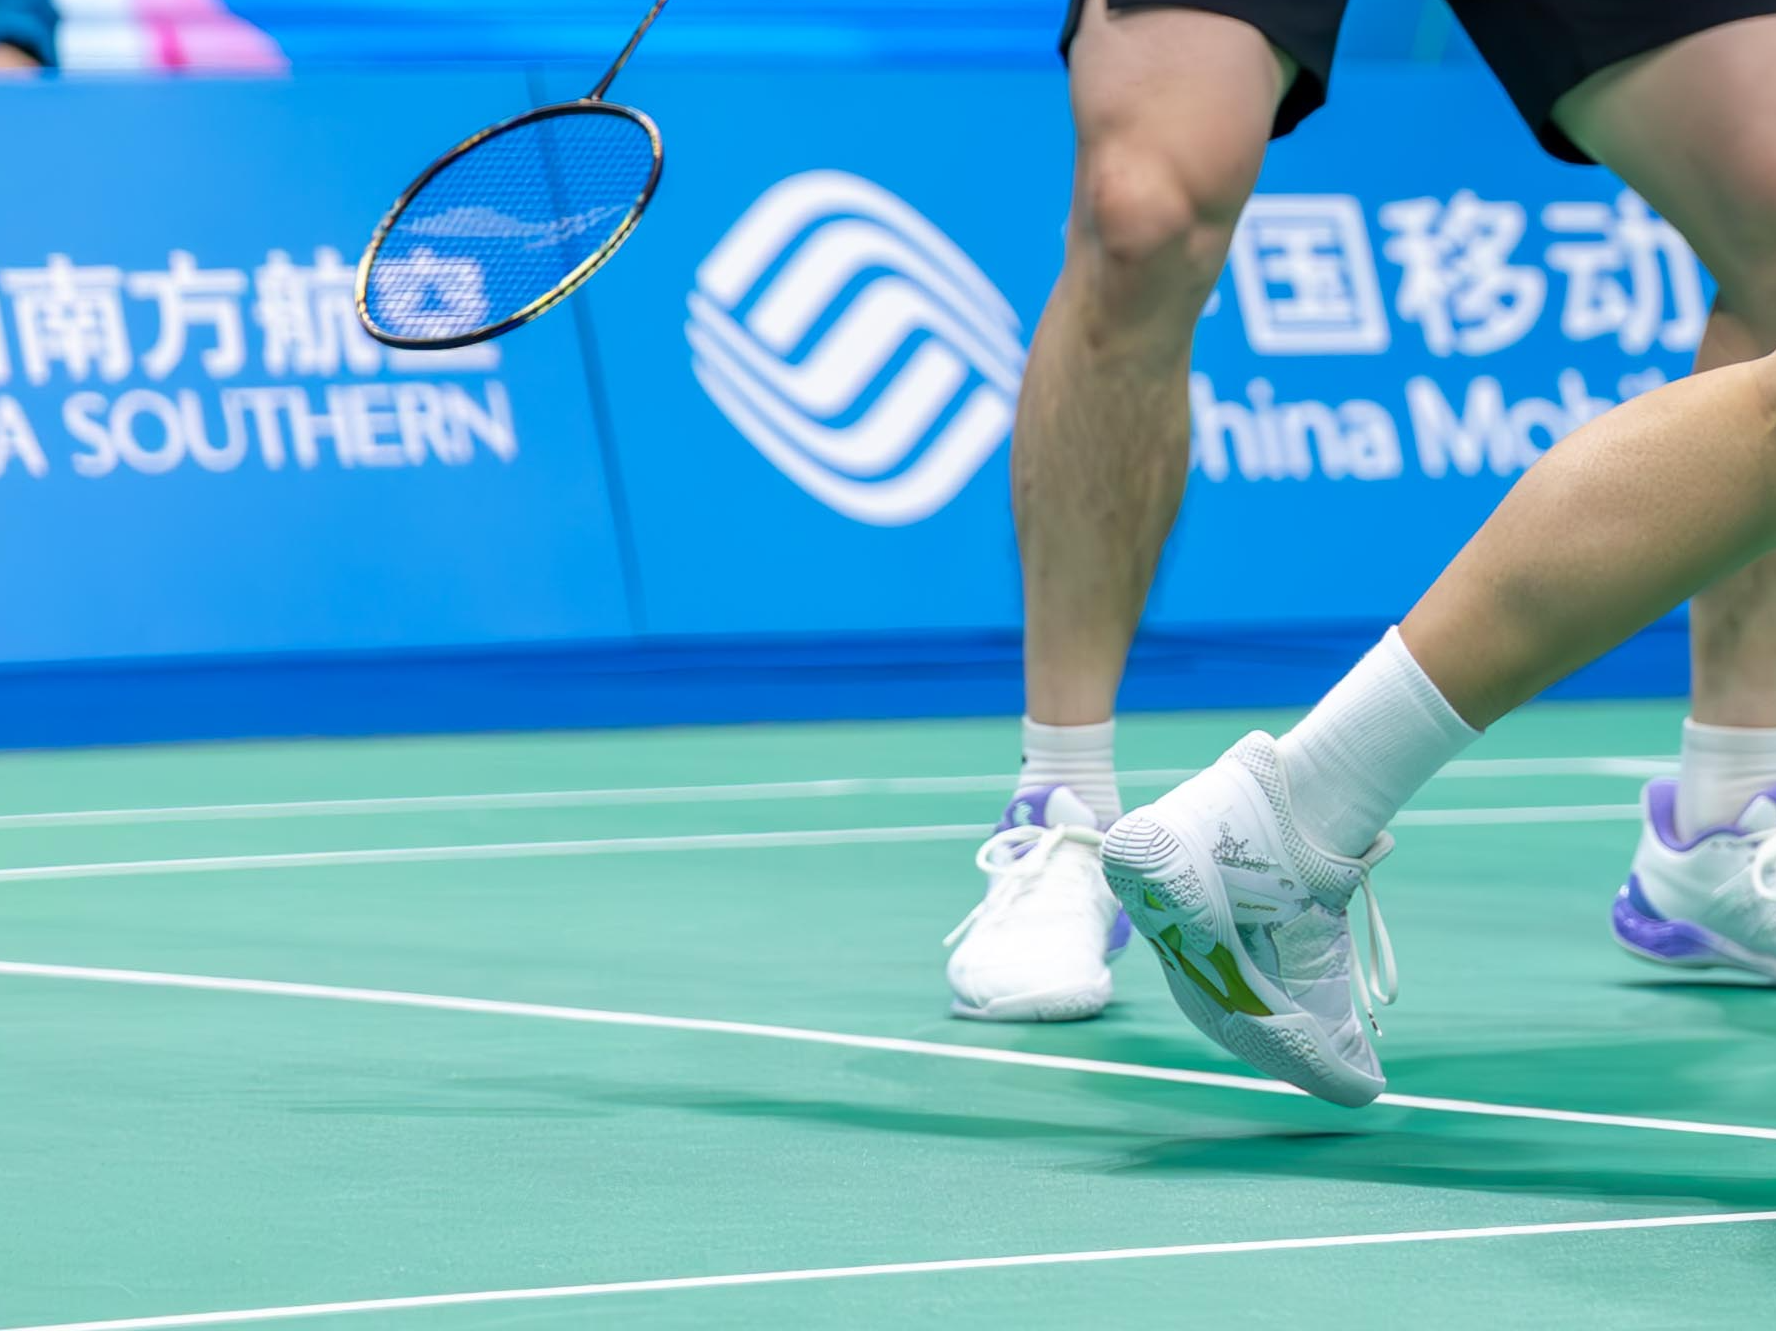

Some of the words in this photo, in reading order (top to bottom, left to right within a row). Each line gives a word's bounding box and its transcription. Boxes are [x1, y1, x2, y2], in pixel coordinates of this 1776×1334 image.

[0, 247, 502, 382] 南方航空
[1203, 188, 1706, 357] 国移动
[61, 381, 519, 479] SOUTHERN
[1188, 371, 1404, 481] hina
